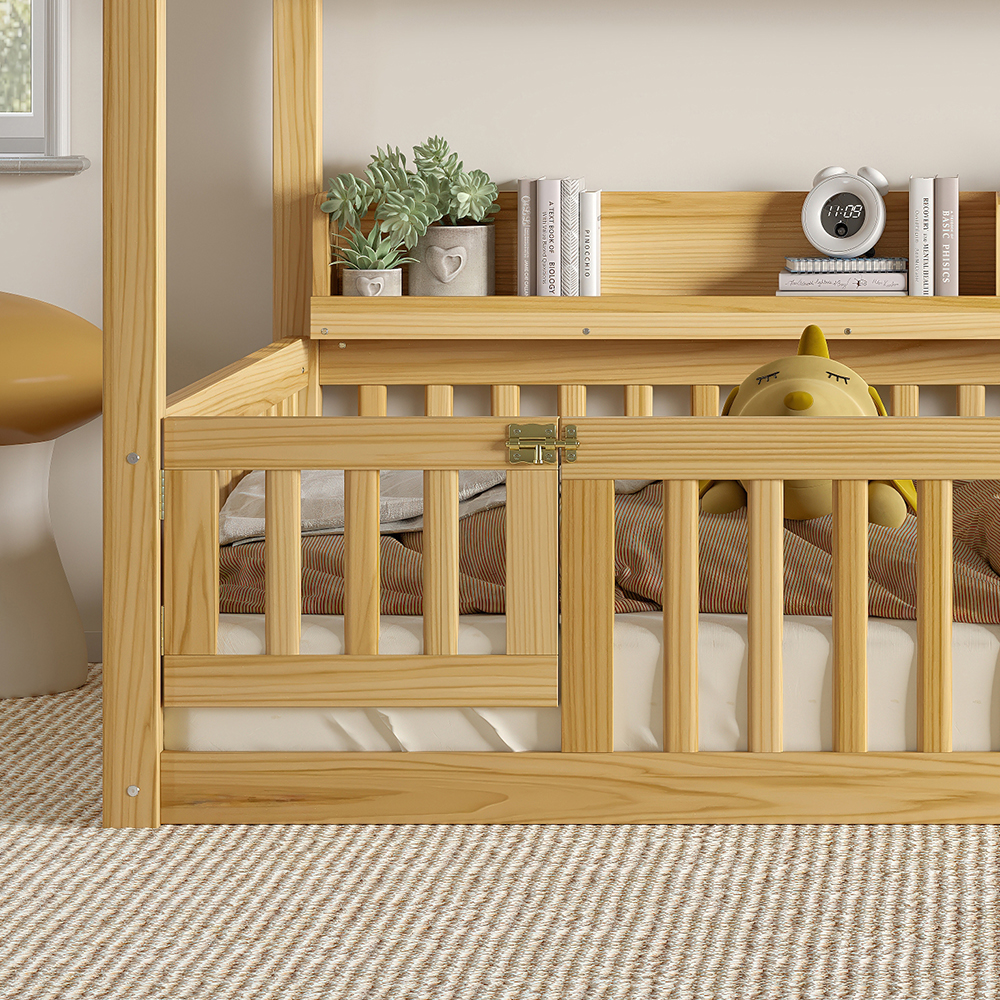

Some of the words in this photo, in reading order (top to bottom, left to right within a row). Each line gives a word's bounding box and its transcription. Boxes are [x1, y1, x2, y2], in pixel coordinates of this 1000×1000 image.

[826, 204, 863, 218] 11:09
[942, 210, 950, 239] BASIC
[549, 245, 554, 254] OF
[942, 244, 950, 283] PHISICS
